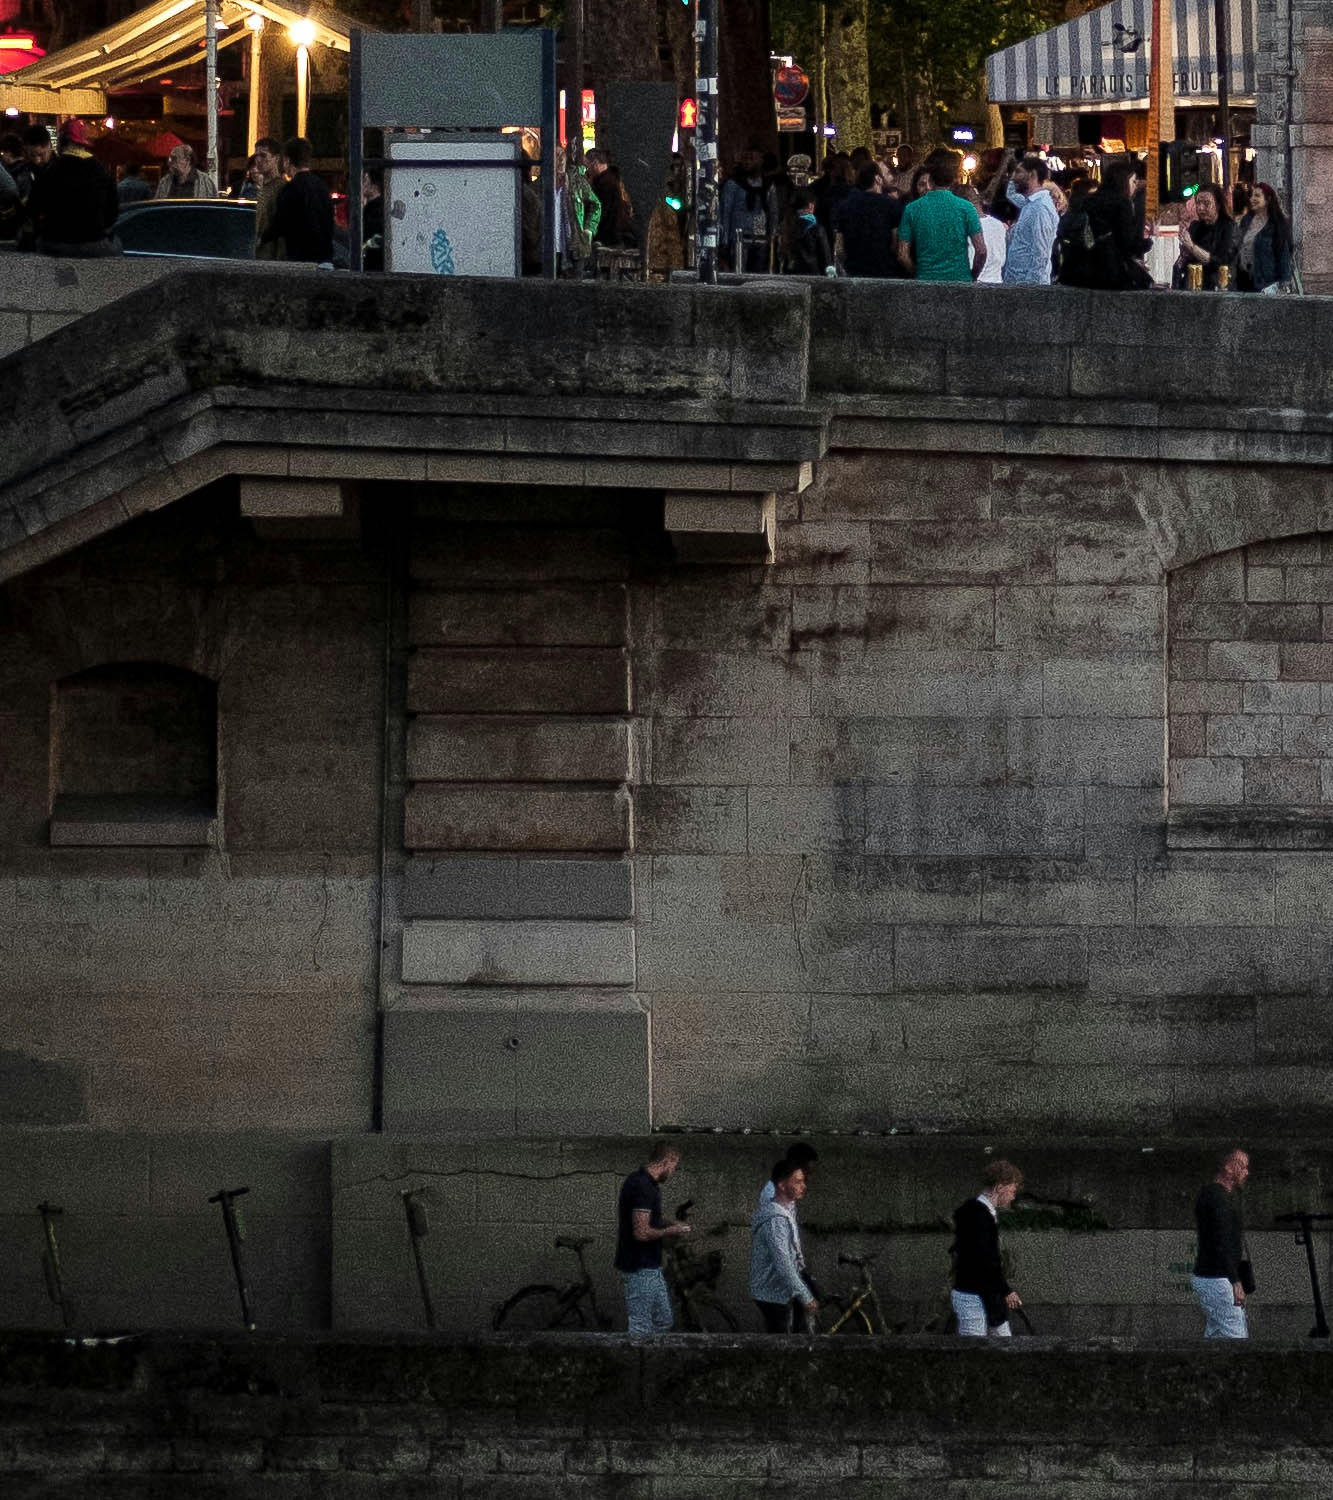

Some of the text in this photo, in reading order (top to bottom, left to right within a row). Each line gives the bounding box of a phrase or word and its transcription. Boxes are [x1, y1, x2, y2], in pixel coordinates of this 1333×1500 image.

[1045, 76, 1060, 96] LE
[1070, 74, 1133, 95] PARADIS
[1173, 71, 1214, 93] FRUIT
